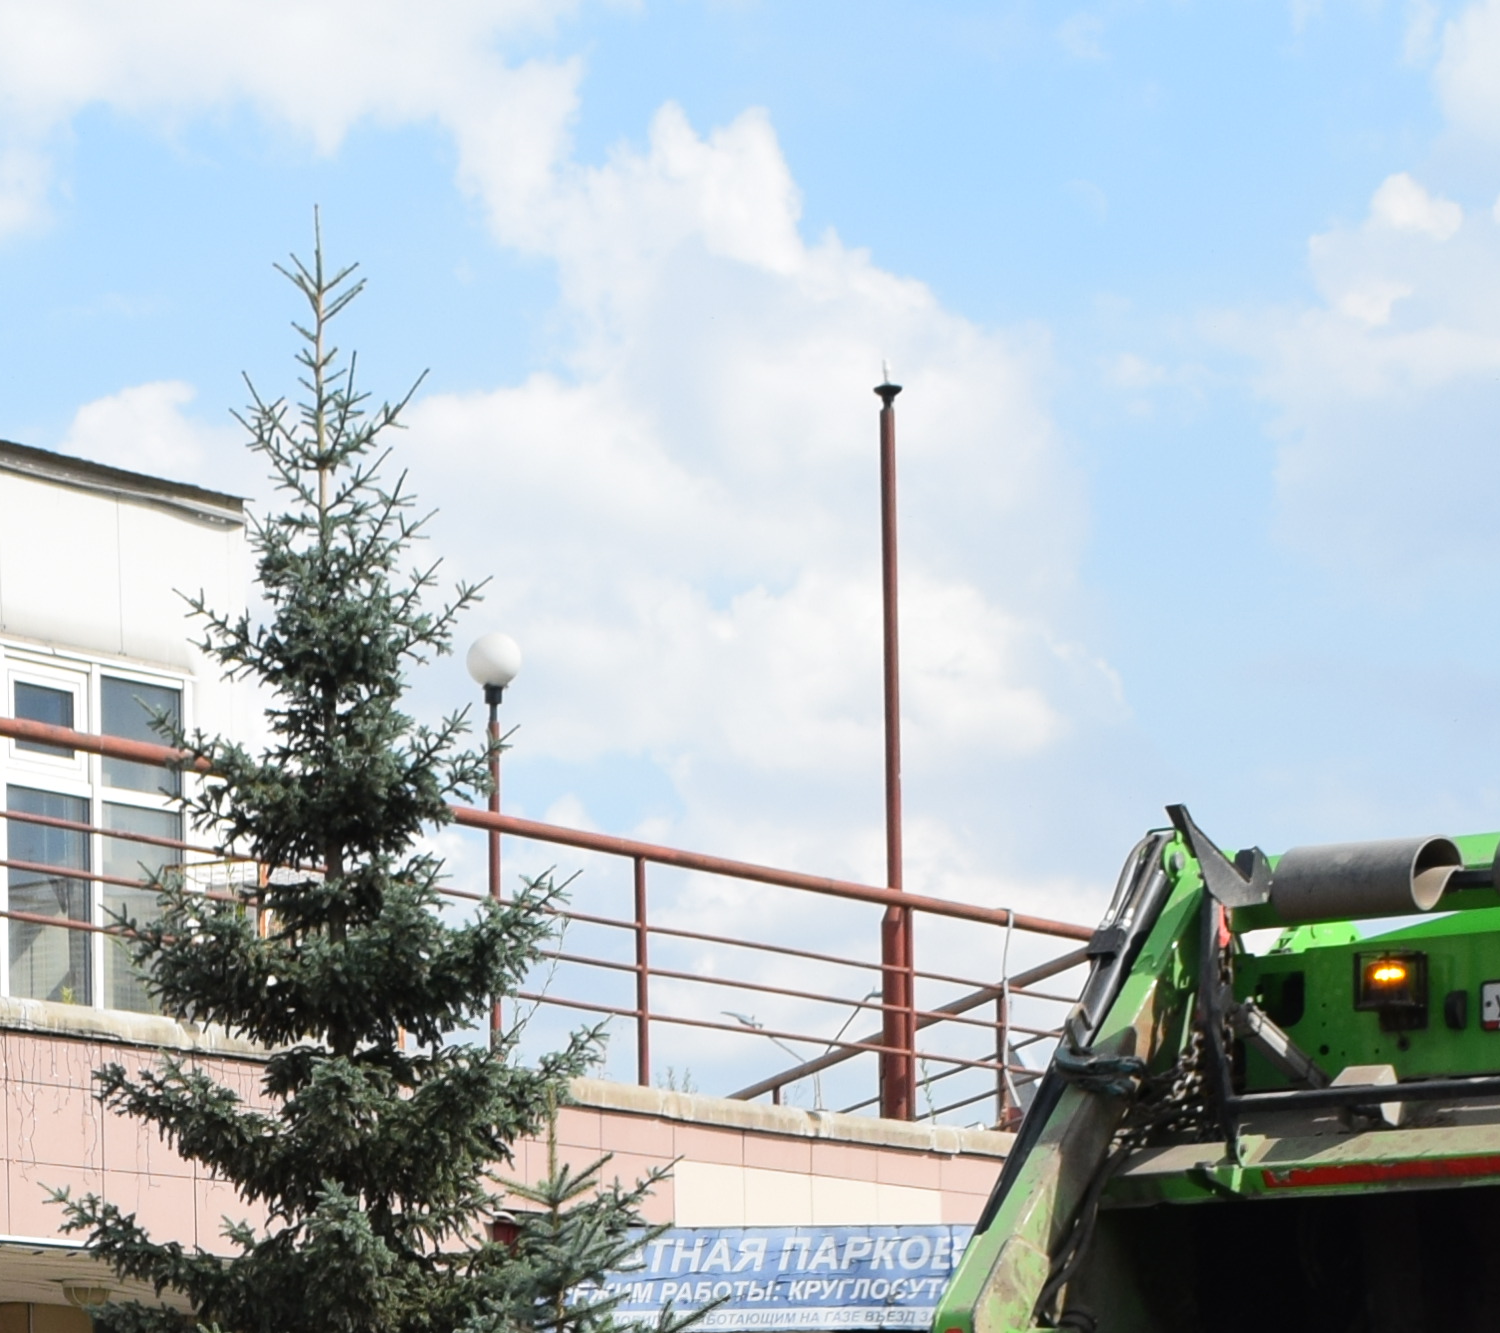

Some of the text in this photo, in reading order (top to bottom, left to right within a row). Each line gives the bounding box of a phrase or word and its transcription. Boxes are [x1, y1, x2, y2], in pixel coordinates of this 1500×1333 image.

[605, 1237, 768, 1273] АТНАЯ
[565, 1280, 655, 1305] ЕЖИМ
[659, 1277, 782, 1305] РАБОТЫ:
[800, 1311, 821, 1323] НА
[824, 1310, 863, 1323] ГАЗЕ
